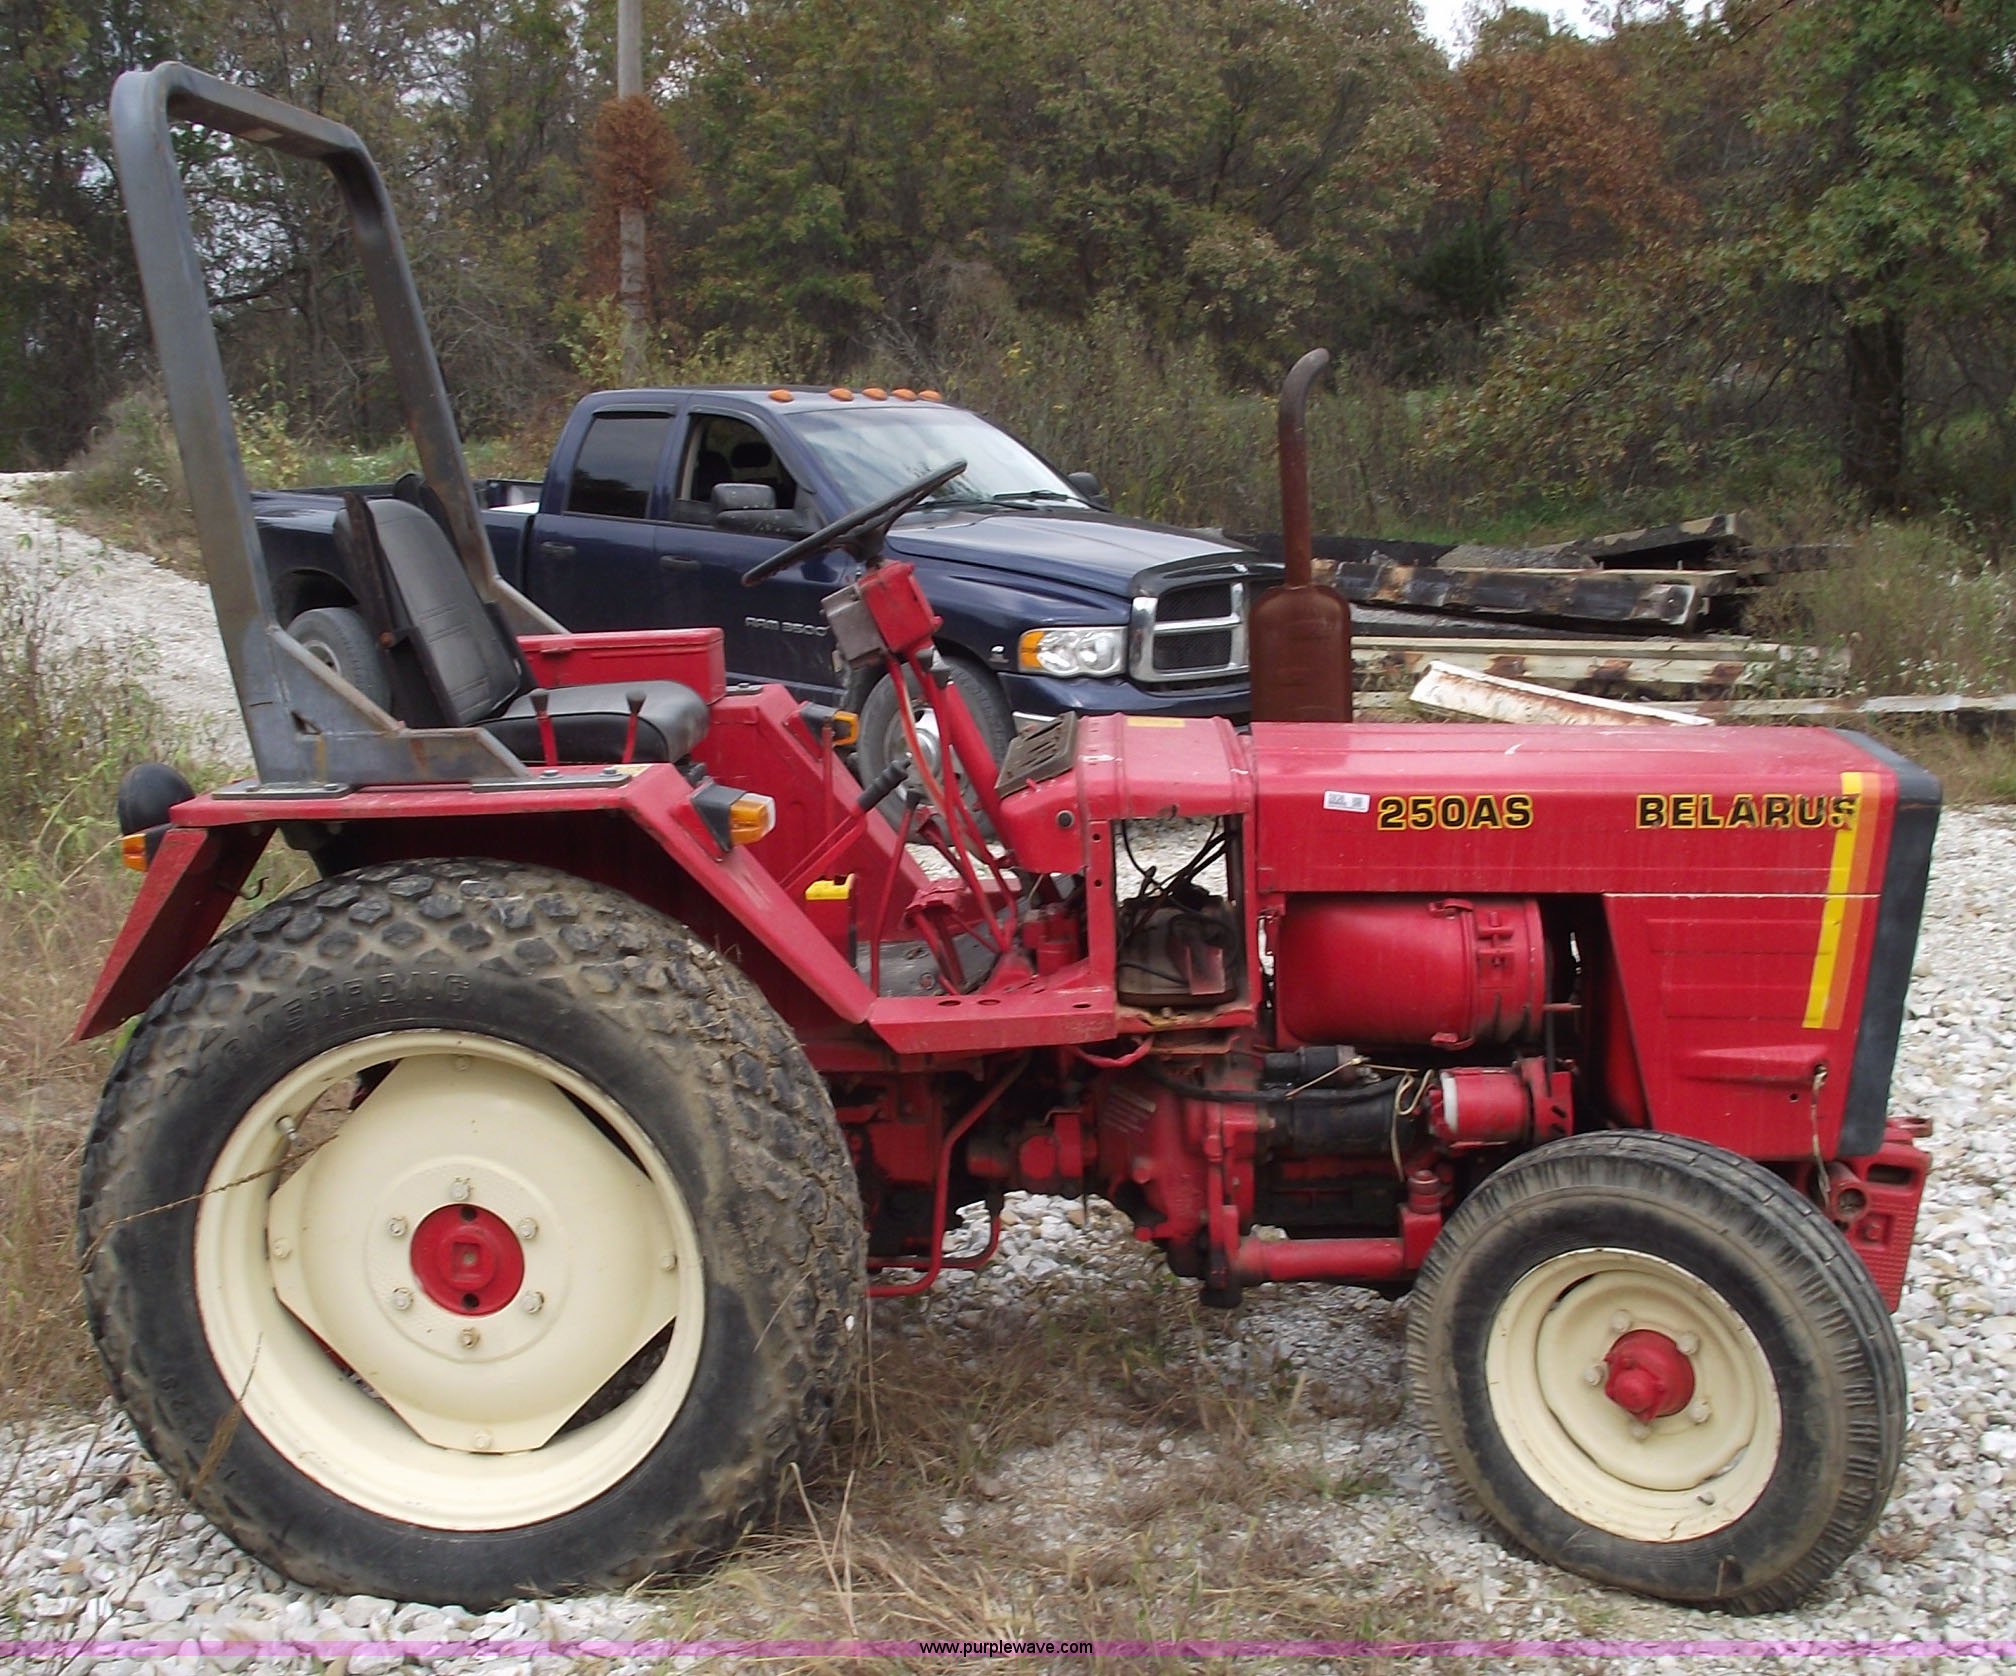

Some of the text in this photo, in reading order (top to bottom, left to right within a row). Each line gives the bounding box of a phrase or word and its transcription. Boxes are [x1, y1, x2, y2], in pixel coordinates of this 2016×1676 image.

[745, 616, 779, 631] RAM
[1377, 794, 1533, 831] 250AS
[1636, 793, 1861, 830] BELARUS
